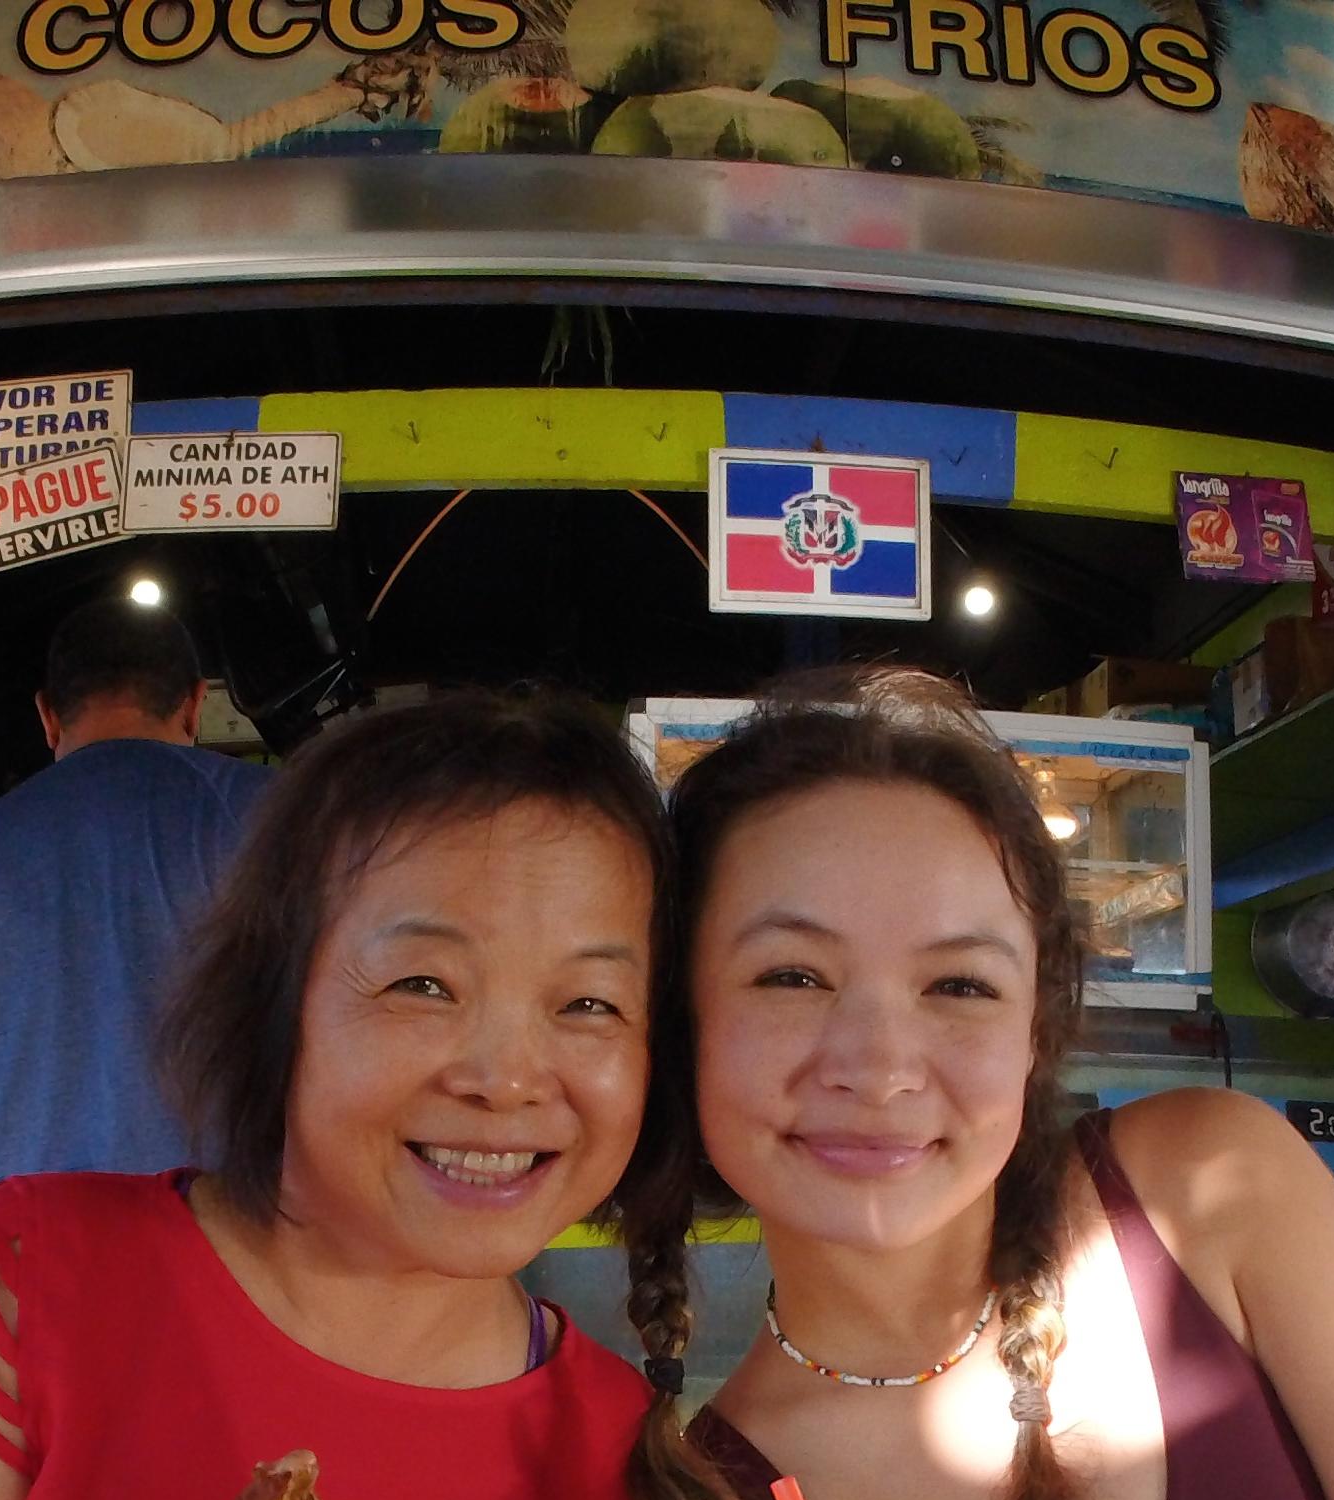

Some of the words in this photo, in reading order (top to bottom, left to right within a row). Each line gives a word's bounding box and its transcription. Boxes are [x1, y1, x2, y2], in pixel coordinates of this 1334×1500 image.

[17, 0, 525, 75] COCOS
[820, 0, 1222, 113] FRIOS
[69, 379, 115, 404] DE
[170, 442, 298, 463] CANTIDAD
[134, 467, 233, 488] MINIMA
[242, 466, 272, 485] DE
[281, 466, 330, 485] ATH
[178, 491, 282, 523] $5.00
